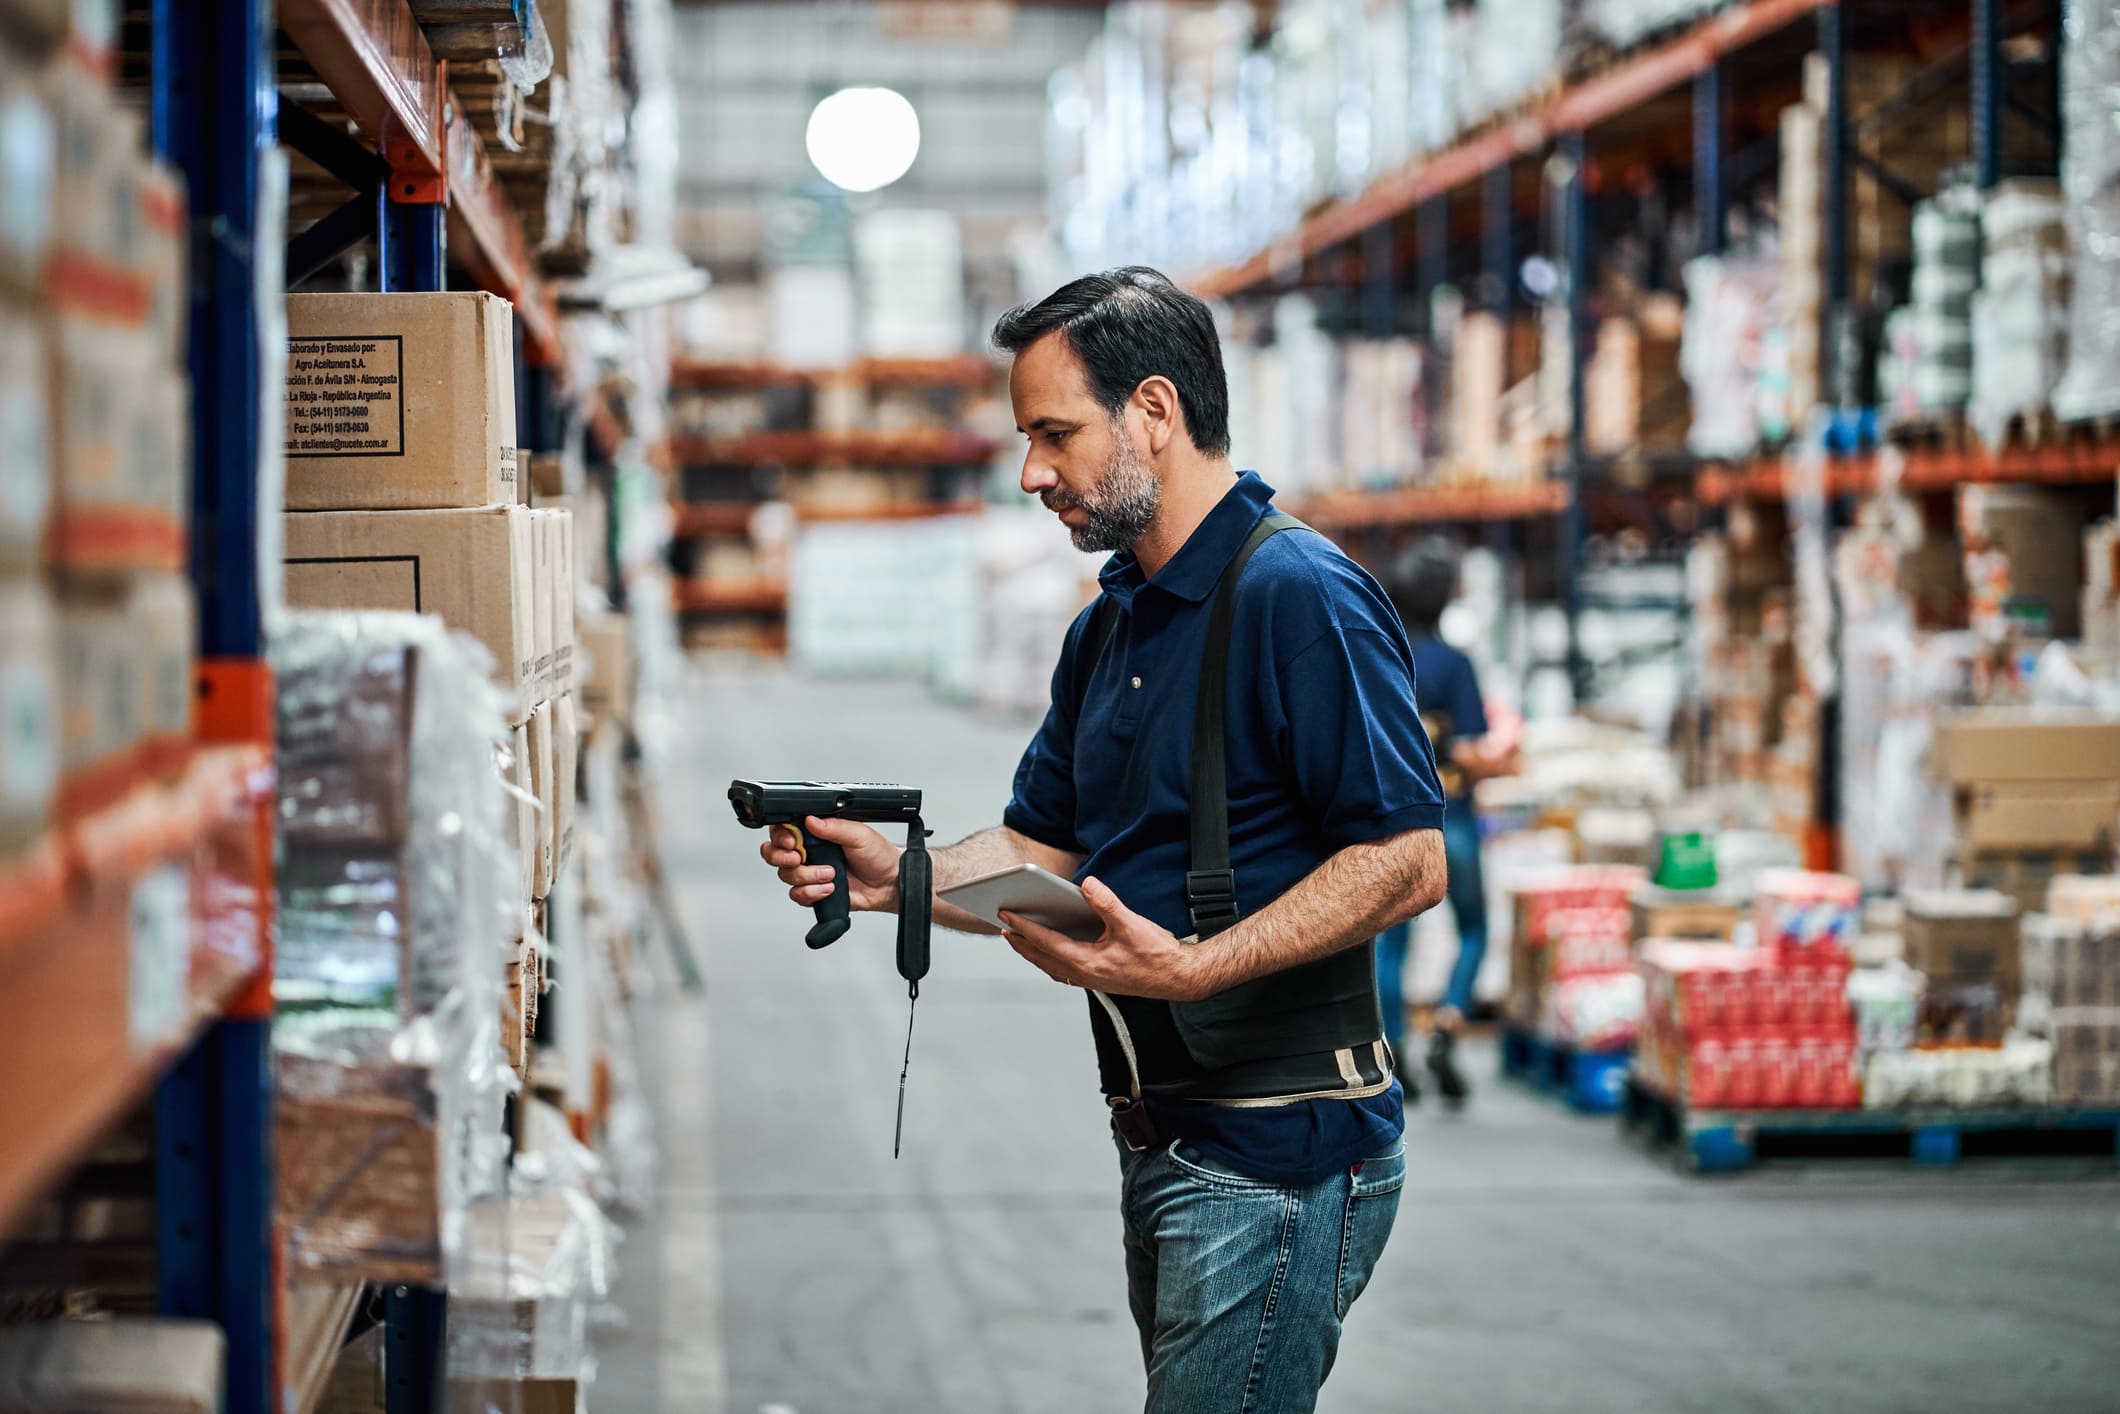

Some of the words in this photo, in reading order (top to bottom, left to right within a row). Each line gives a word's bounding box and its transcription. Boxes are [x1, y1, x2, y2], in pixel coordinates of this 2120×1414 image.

[320, 345, 325, 356] y
[326, 342, 360, 353] Envasado
[362, 344, 376, 354] por:
[296, 359, 312, 372] Agro
[314, 358, 350, 369] Aceitunera
[352, 358, 366, 368] S.A.
[307, 375, 313, 385] F.
[314, 375, 324, 385] de
[325, 372, 342, 384] Ávila
[344, 374, 356, 384] S/N
[289, 392, 298, 401] La
[300, 391, 317, 403] Rioja
[323, 390, 356, 403] República
[358, 390, 391, 402] Argentina
[310, 407, 332, 419] (54-11)
[294, 423, 309, 433] Fax:
[310, 423, 333, 435] (54-11)
